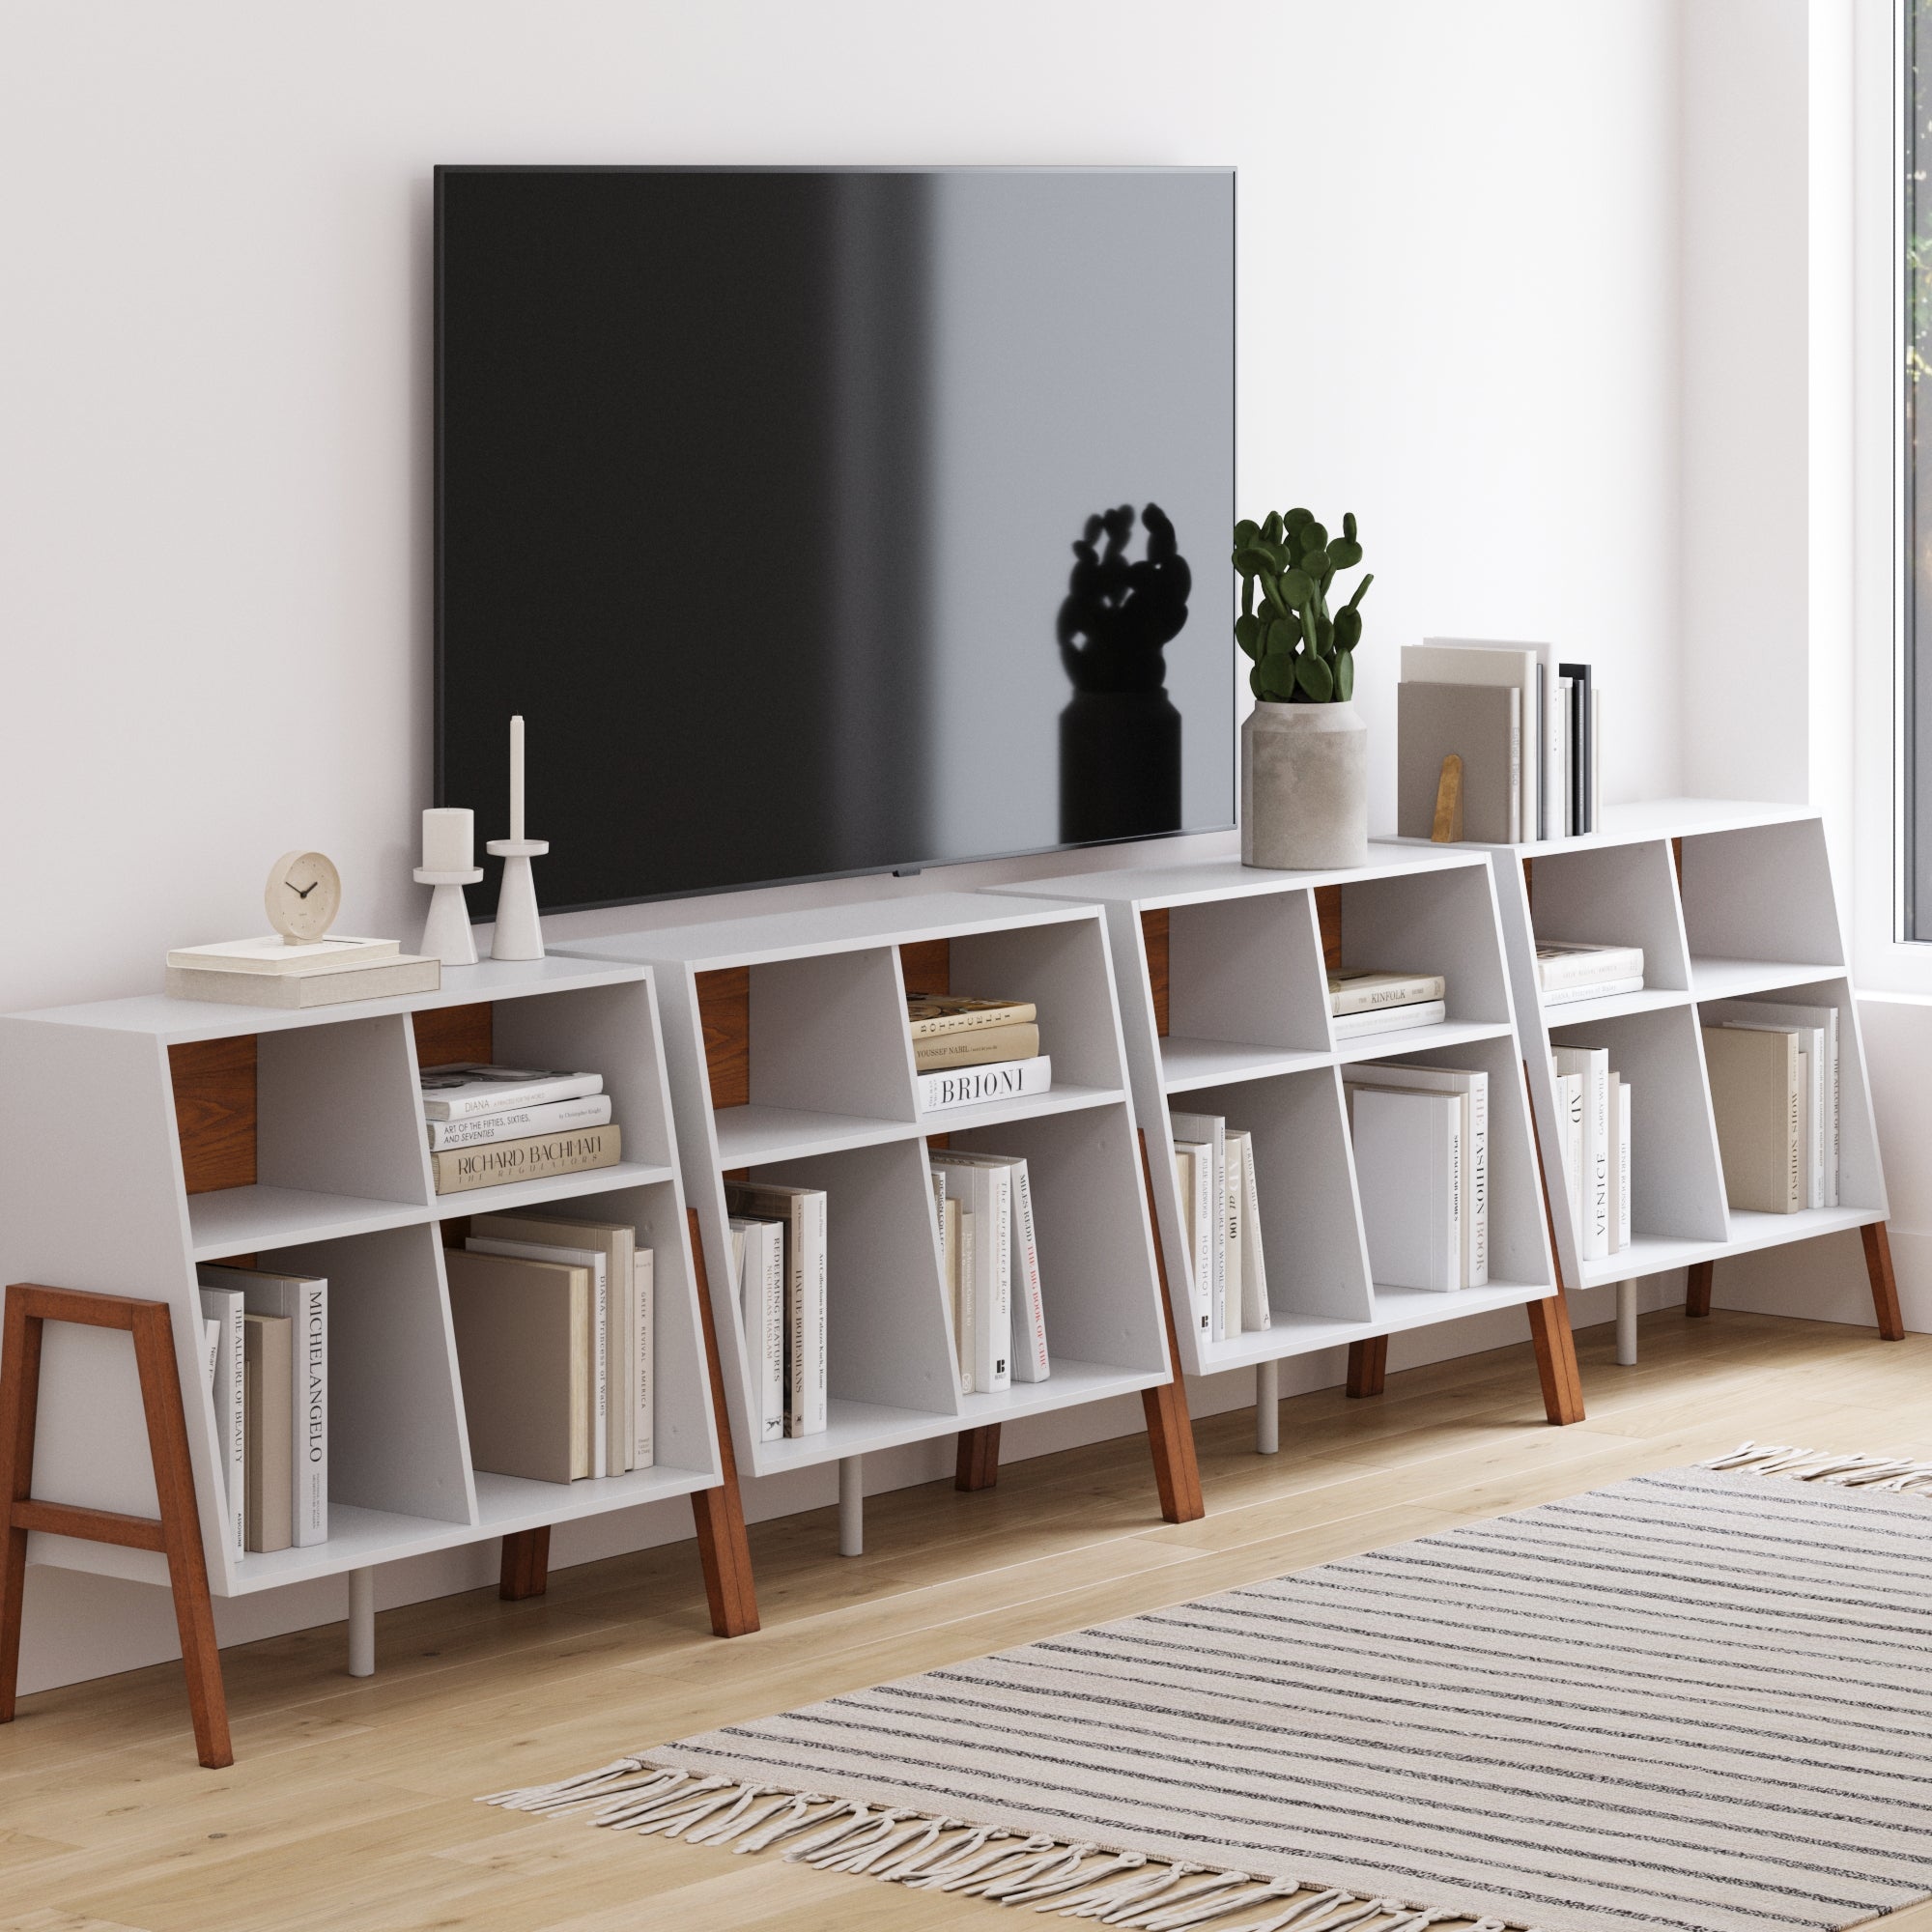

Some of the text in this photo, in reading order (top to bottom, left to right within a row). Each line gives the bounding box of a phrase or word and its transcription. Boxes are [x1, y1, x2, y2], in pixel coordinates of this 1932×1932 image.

[1371, 989, 1406, 1004] KINFOLK
[920, 1014, 1010, 1033] BOTTICELLI
[917, 1045, 970, 1058] YOUSSEF NABIL
[941, 1067, 1025, 1104] BRIONI
[465, 1099, 490, 1113] DIANA
[1571, 1090, 1581, 1123] AD
[443, 1114, 530, 1134] ART OF THE FIFTIES, SIXTIES,
[1833, 1119, 1838, 1131] OF
[443, 1129, 495, 1144] AND SEVENTIES
[458, 1136, 601, 1176] RICHARD BACHMAN
[1229, 1195, 1236, 1209] at
[1597, 1151, 1605, 1236] VENICE
[1024, 1210, 1033, 1242] REDD
[1229, 1216, 1237, 1238] 100
[1219, 1234, 1224, 1245] OF
[1027, 1245, 1036, 1268] THE
[1033, 1292, 1041, 1322] BOOK
[1037, 1324, 1043, 1339] OF
[309, 1292, 322, 1463] MICHELANGELO
[599, 1370, 606, 1380] of
[235, 1390, 242, 1407] OF
